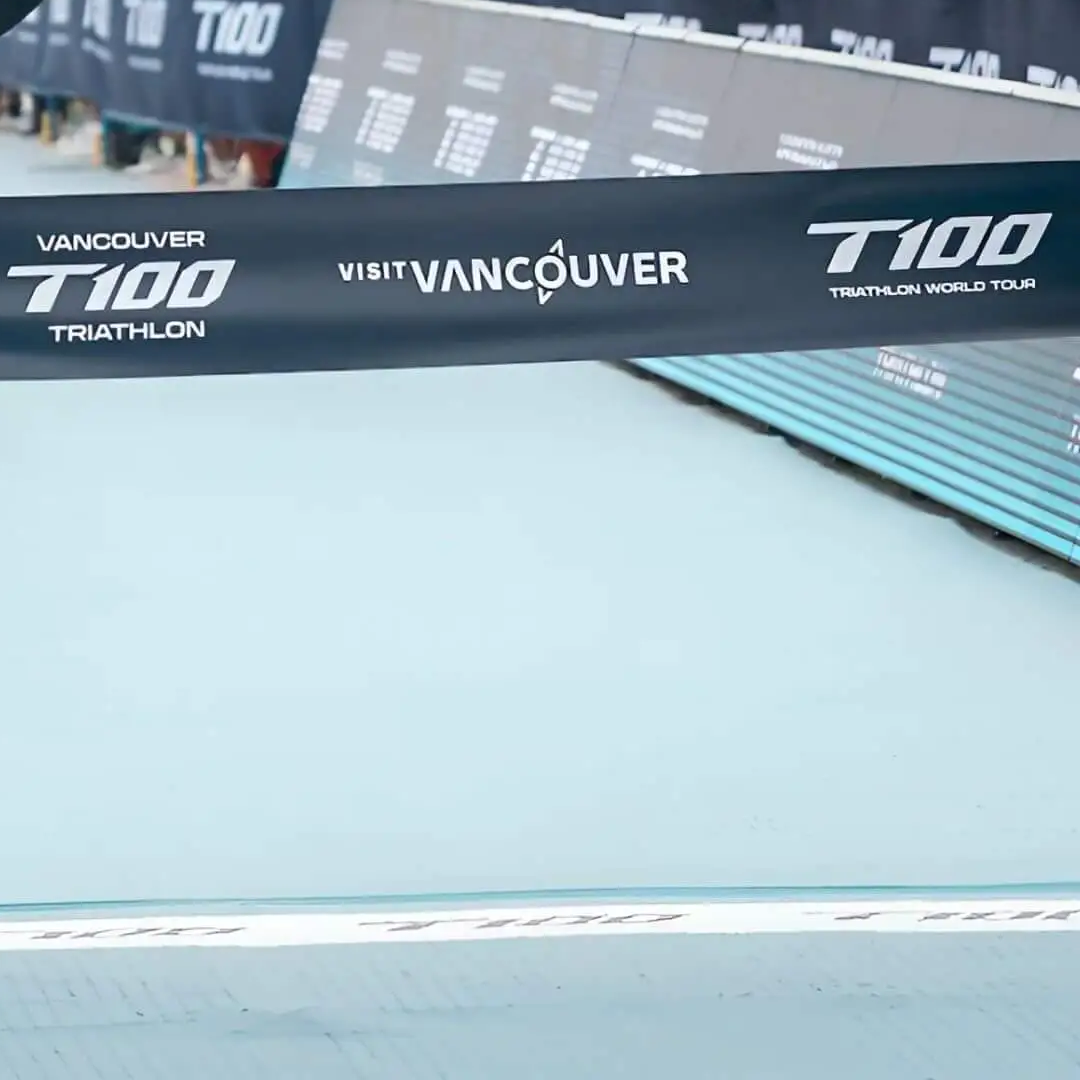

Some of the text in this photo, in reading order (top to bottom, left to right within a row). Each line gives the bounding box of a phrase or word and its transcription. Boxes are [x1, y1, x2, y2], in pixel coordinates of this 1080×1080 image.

[36, 230, 206, 252] VANCOUVER
[807, 213, 1053, 274] T100
[7, 259, 236, 313] T100
[338, 244, 689, 300] VISIT VANCOUVER
[829, 278, 1036, 298] TRIATHLON WORLD TOUR
[48, 320, 206, 342] TRIATHLON
